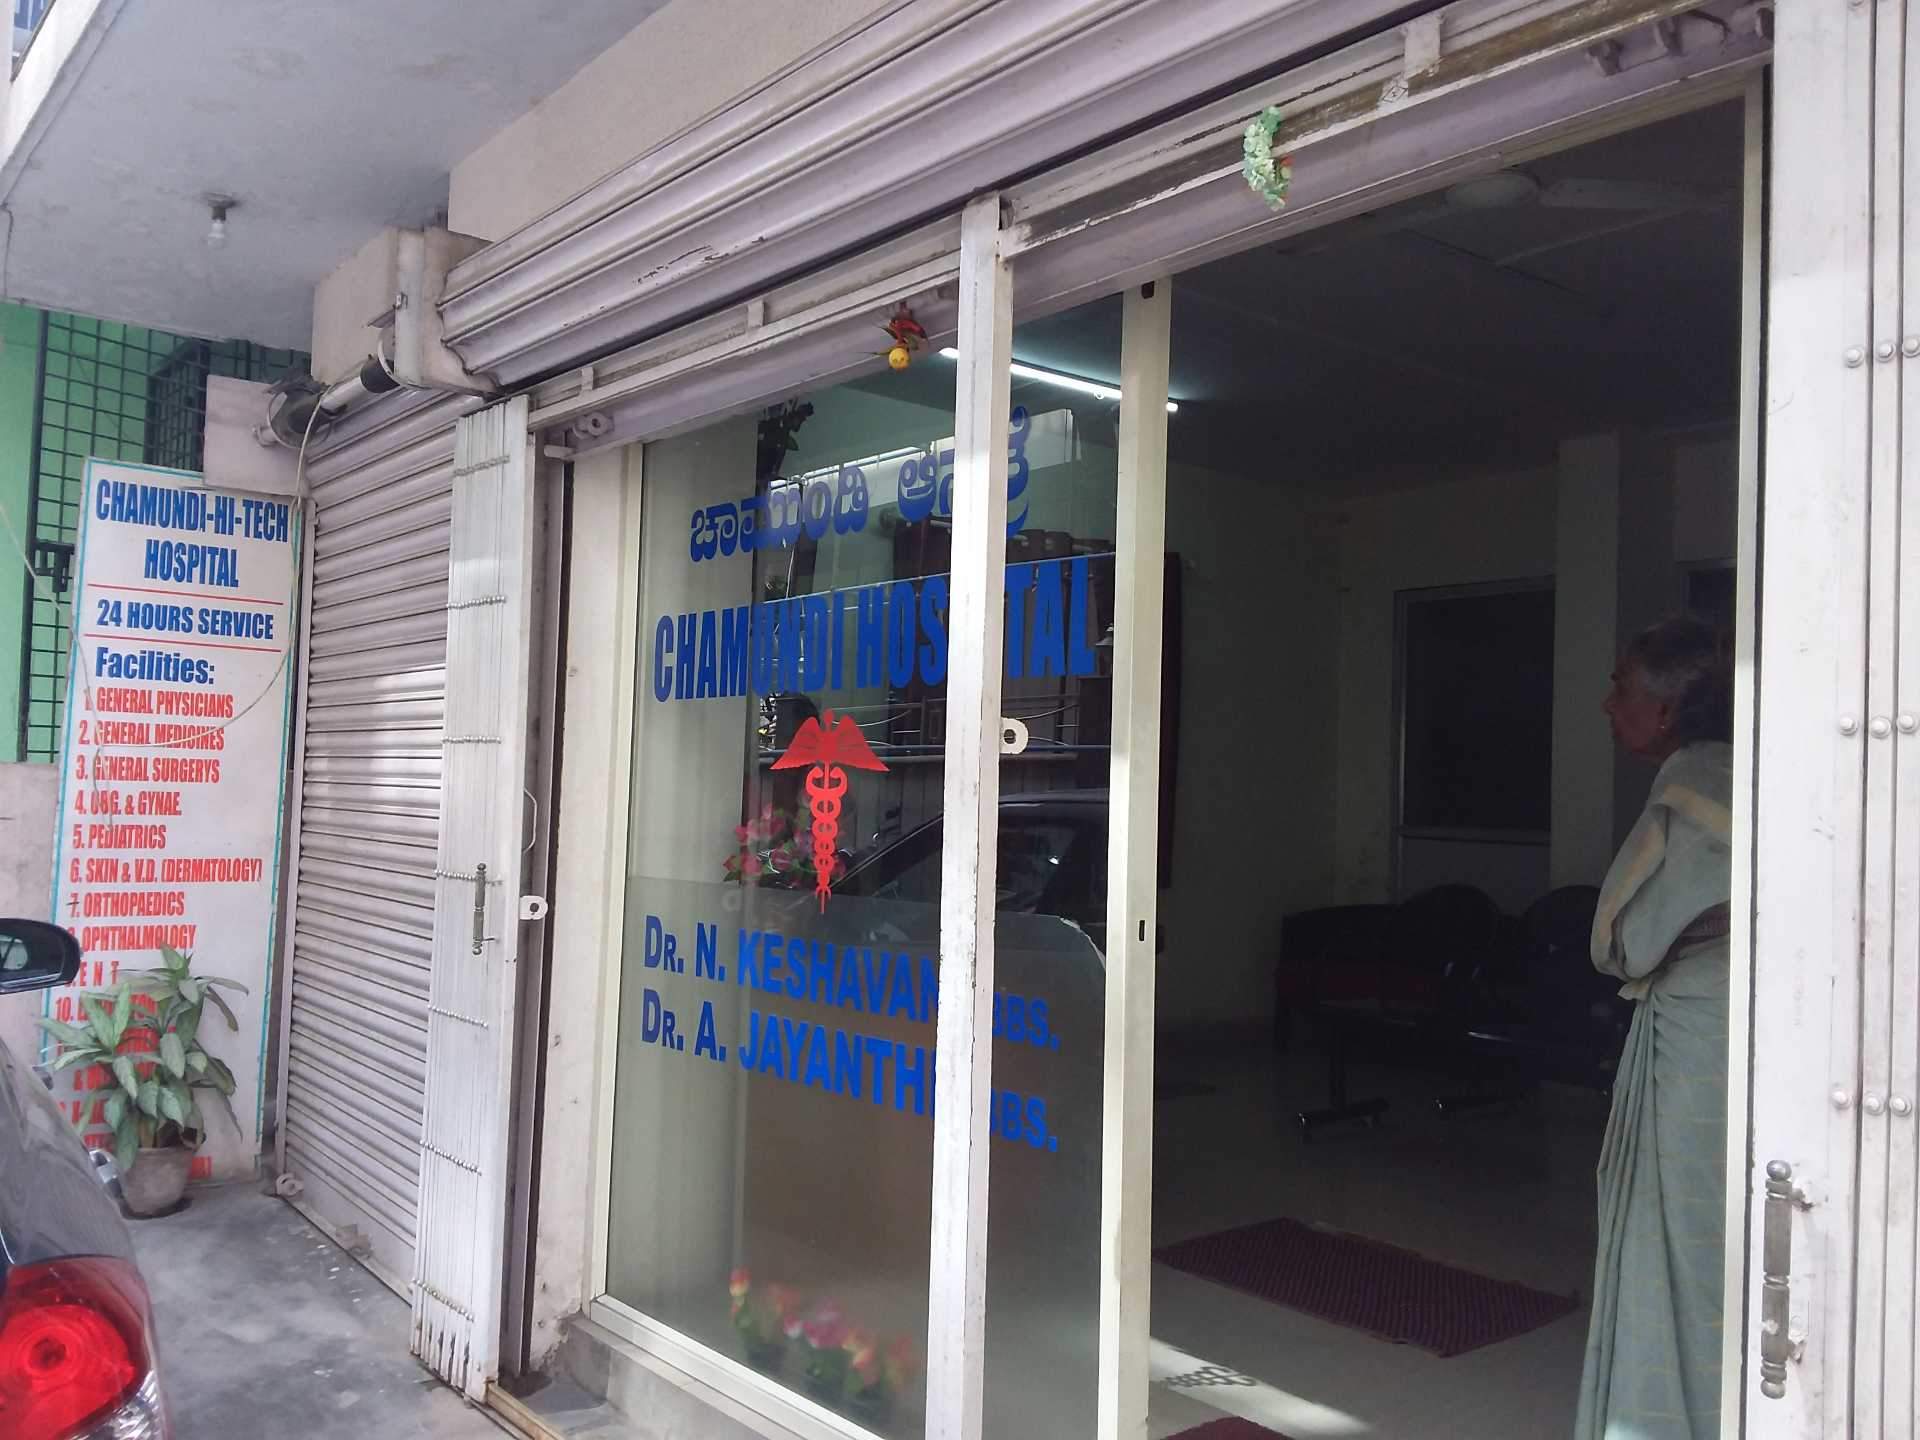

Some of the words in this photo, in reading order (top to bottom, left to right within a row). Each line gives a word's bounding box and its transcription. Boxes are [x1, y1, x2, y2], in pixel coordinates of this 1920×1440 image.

[96, 479, 289, 543] CHAMUNDI-HI-TECH
[144, 538, 239, 588] HOSPITAL
[96, 599, 122, 627] 24
[127, 602, 193, 633] HOURS
[197, 608, 274, 640] SERVICE
[654, 588, 844, 704] CHAMUNDI
[856, 557, 1096, 690] HOSTAL
[95, 647, 215, 685] Facilities:
[96, 687, 153, 714] GENERAL
[156, 690, 234, 719] PHYSICIANS
[94, 720, 151, 746] GENERAL
[154, 723, 224, 751] MEDICINES
[75, 754, 88, 780] 3.
[94, 756, 149, 782] GENERAL
[152, 757, 220, 783] SURGERYS
[74, 790, 87, 815] 4.
[125, 794, 134, 815] &
[72, 824, 84, 849] 5.
[88, 824, 167, 849] PEDIATRICS
[70, 858, 82, 883] 6.
[86, 858, 119, 883] SKIN
[121, 862, 131, 883] &
[161, 858, 263, 883] (DERMATOLOGY)
[84, 891, 185, 917] ORTHOPAEDICS
[82, 924, 197, 952] OPHTHALMOLOGY
[695, 921, 725, 982] N.
[55, 998, 74, 1023] 10.
[694, 1000, 727, 1063] A.
